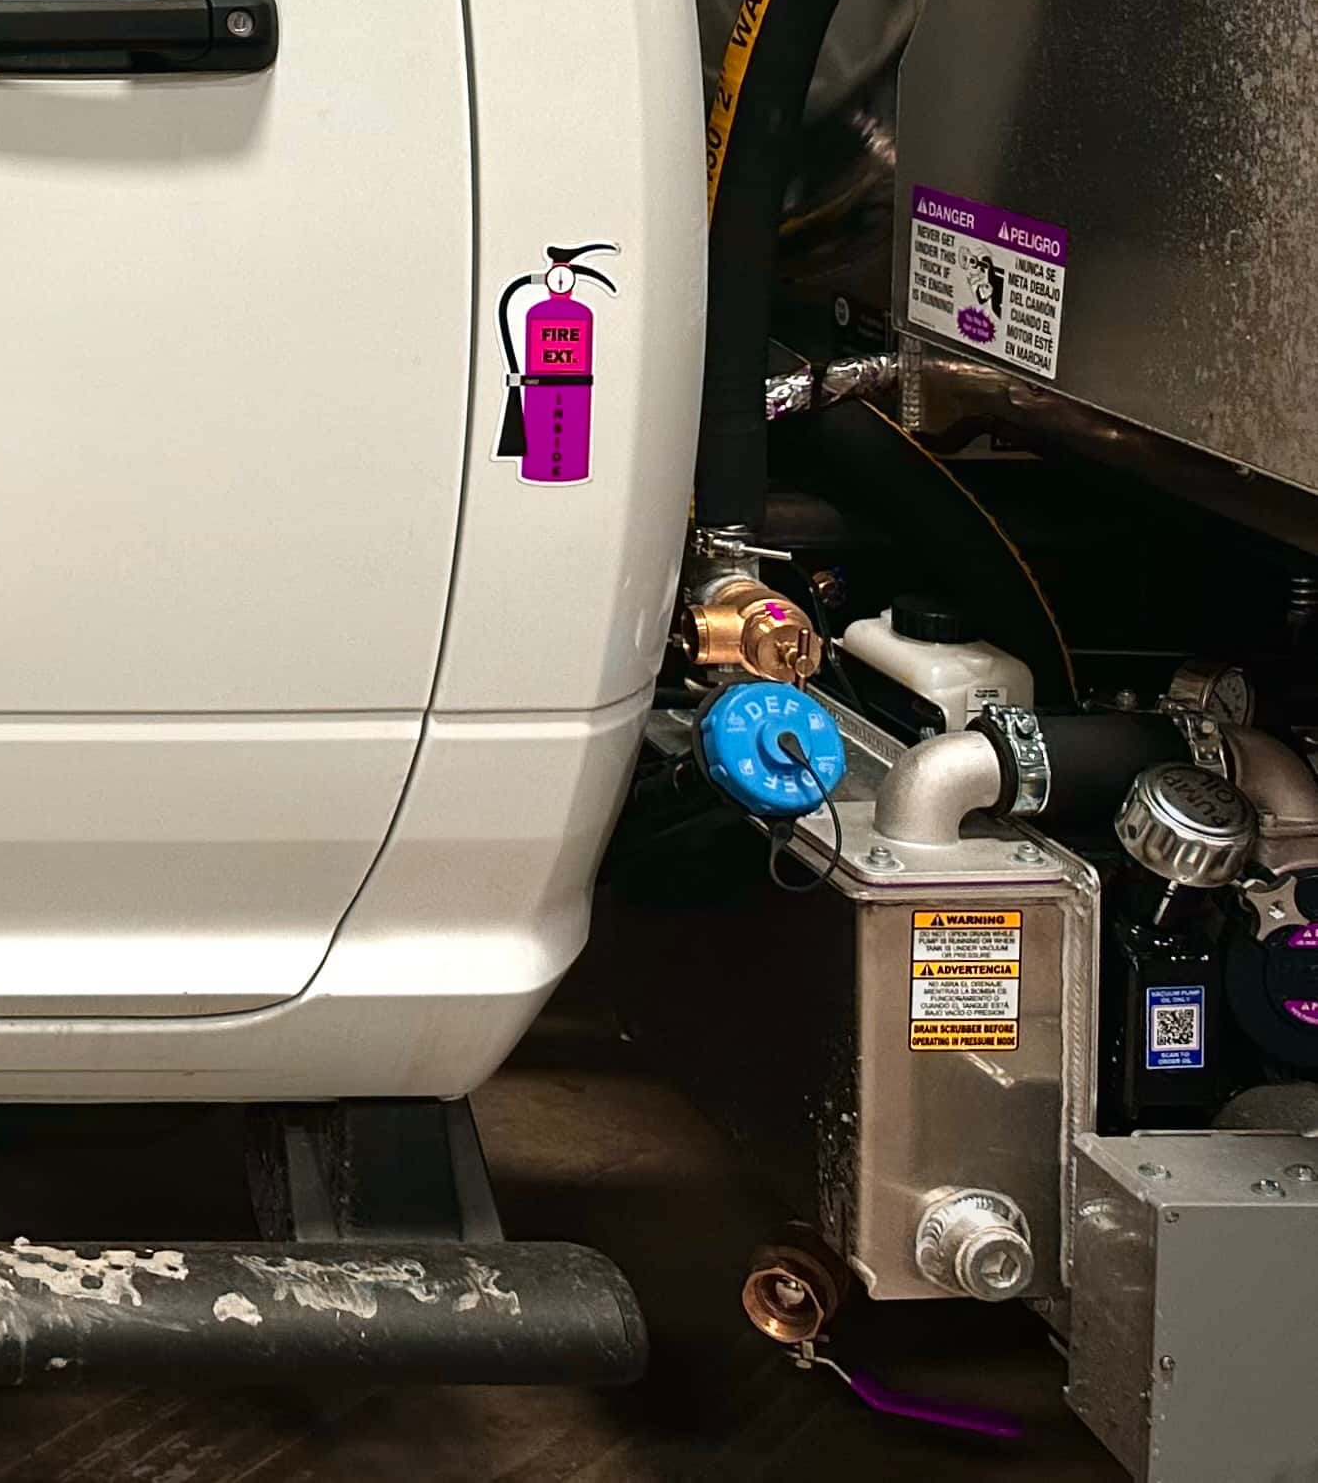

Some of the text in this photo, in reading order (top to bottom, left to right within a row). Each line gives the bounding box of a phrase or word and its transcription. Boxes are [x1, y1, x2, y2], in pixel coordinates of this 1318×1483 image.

[928, 201, 975, 229] DANGER
[917, 224, 955, 247] NEVER GET
[1010, 227, 1061, 257] PELIGRO
[940, 247, 956, 265] THIS
[1046, 267, 1056, 283] SE
[914, 272, 954, 298] THE ENGINE
[1008, 271, 1060, 302] META DEBAJO
[1009, 290, 1024, 307] DEL
[1010, 308, 1041, 331] CUANDO
[1043, 320, 1052, 335] EL
[541, 327, 581, 342] FIRE
[1006, 324, 1033, 345] MOTOR
[542, 349, 578, 365] EXT.
[1005, 341, 1015, 356] EN
[744, 695, 800, 722] DEF
[946, 915, 1005, 925] WARNING
[937, 965, 1012, 974] ADVERTENCIA
[913, 1024, 1015, 1033] DRAIN SCRUBBER BEFORE
[912, 1037, 1015, 1045] OPERATING IN PRESSURE MODE
